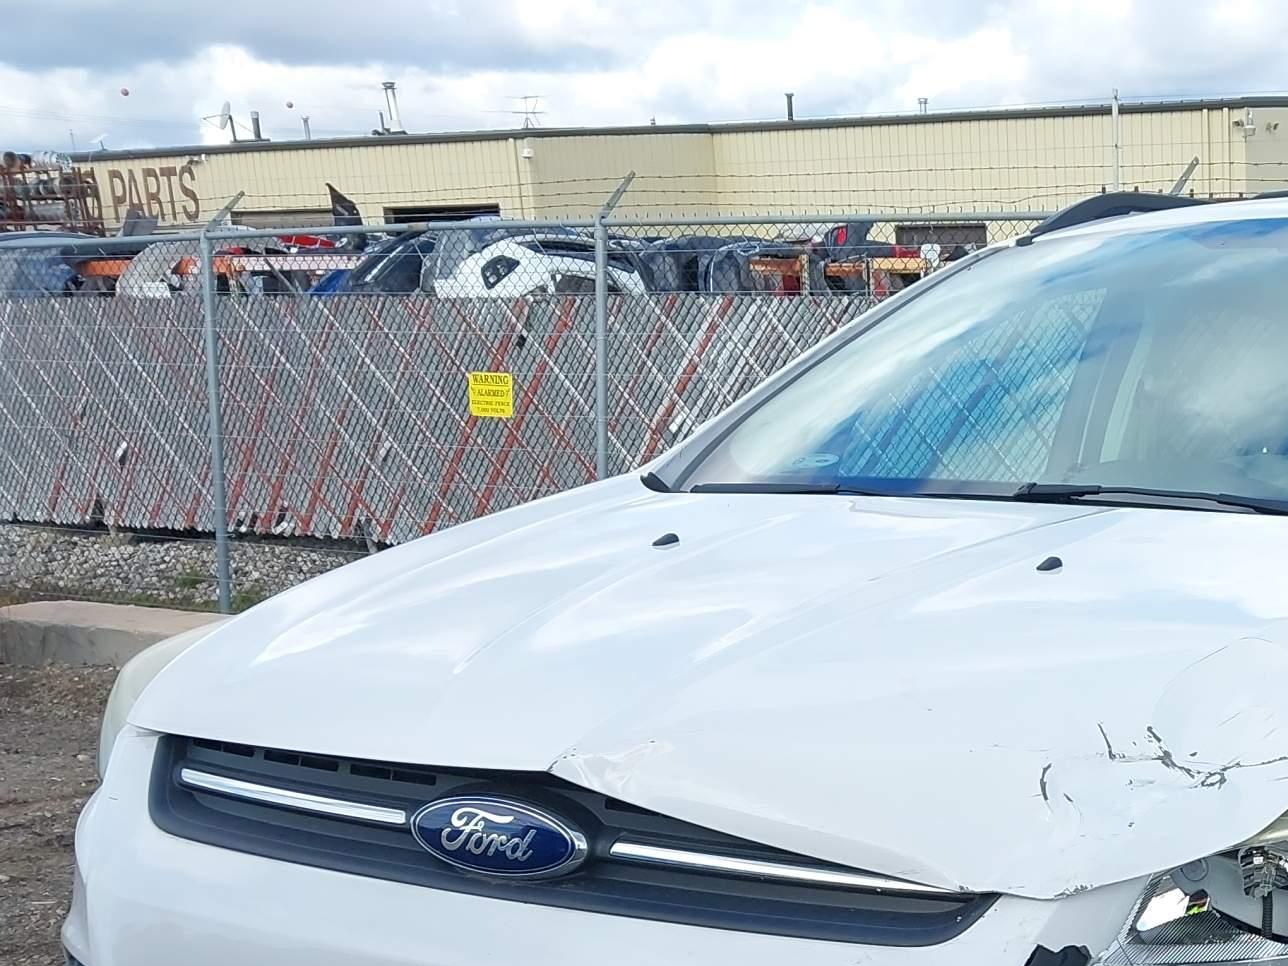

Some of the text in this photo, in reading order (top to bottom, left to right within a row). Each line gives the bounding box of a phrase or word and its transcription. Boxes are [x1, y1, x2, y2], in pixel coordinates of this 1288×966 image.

[108, 165, 200, 223] PARTS
[471, 373, 509, 385] WARNING
[441, 807, 535, 861] Ford
